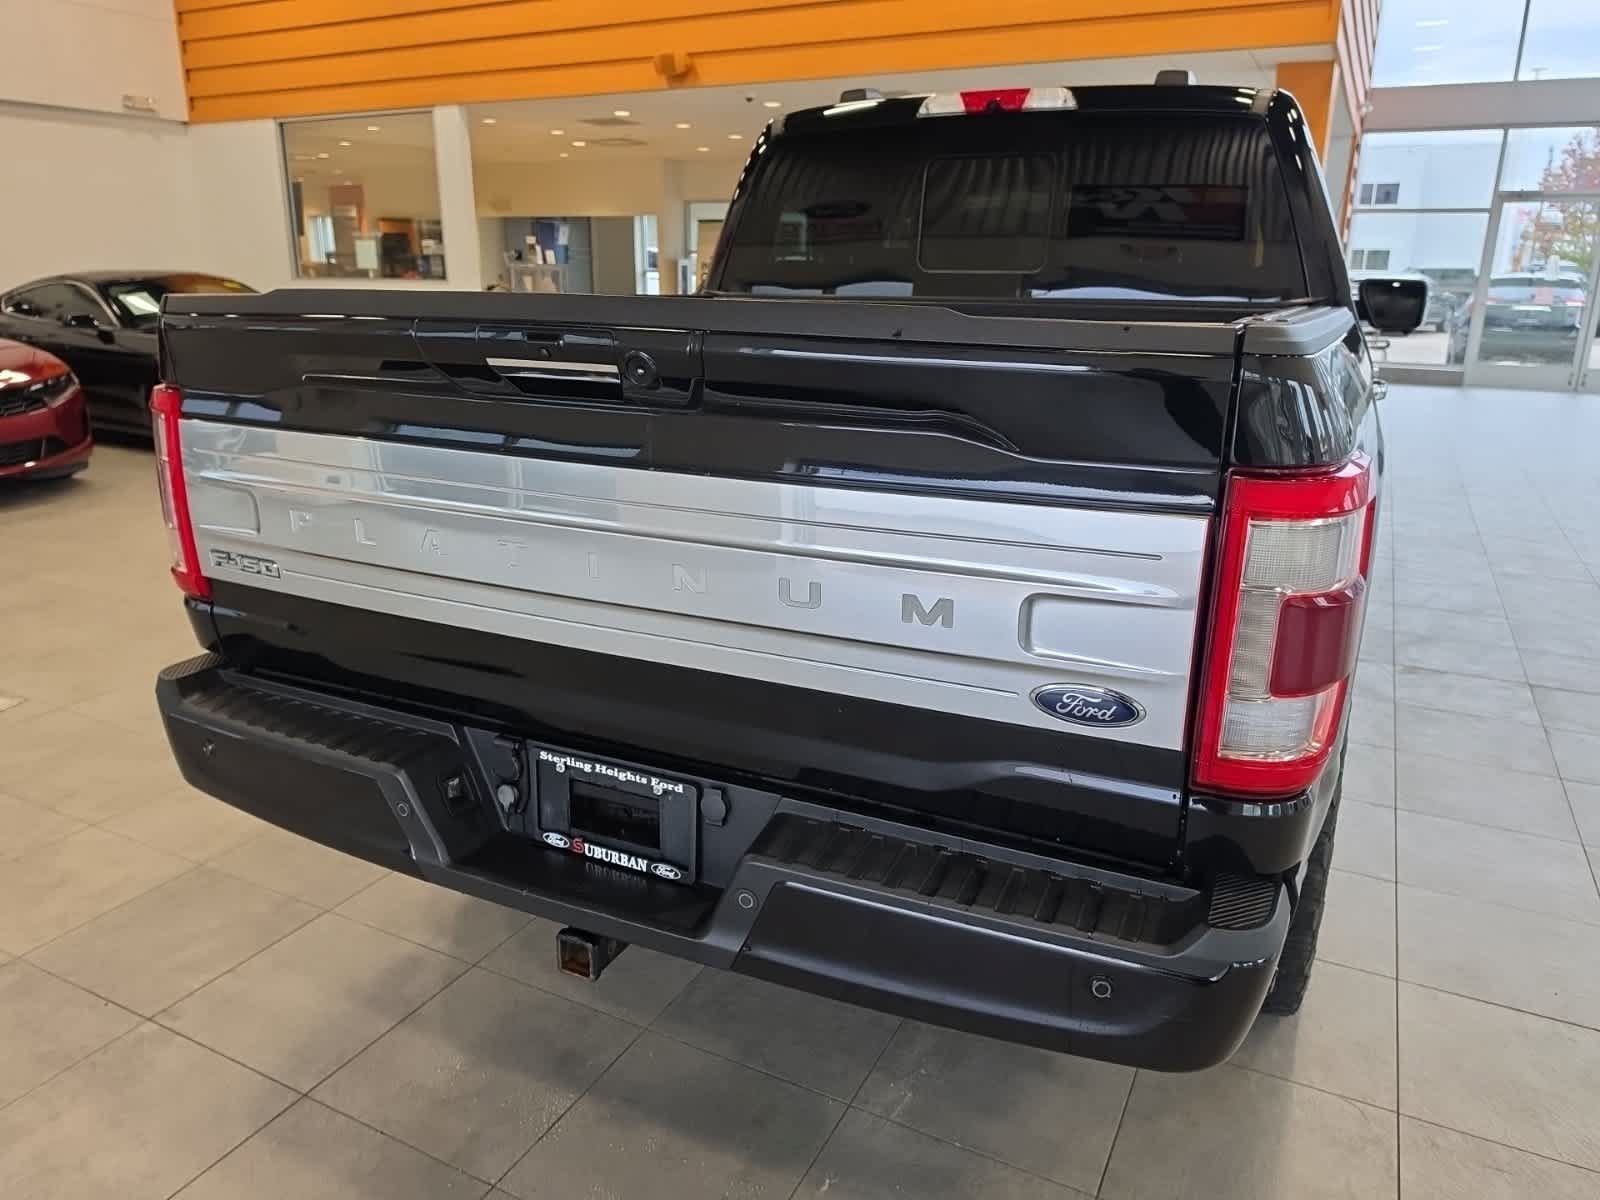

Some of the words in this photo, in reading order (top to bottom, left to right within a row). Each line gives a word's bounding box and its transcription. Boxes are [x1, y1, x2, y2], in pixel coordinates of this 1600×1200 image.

[209, 549, 280, 578] F-150
[289, 509, 954, 629] PLATINUM
[1055, 692, 1118, 721] Ford
[539, 750, 593, 773] Sterling
[594, 763, 648, 785] Heights
[650, 776, 684, 794] Ford
[572, 838, 648, 872] SUBURBAN
